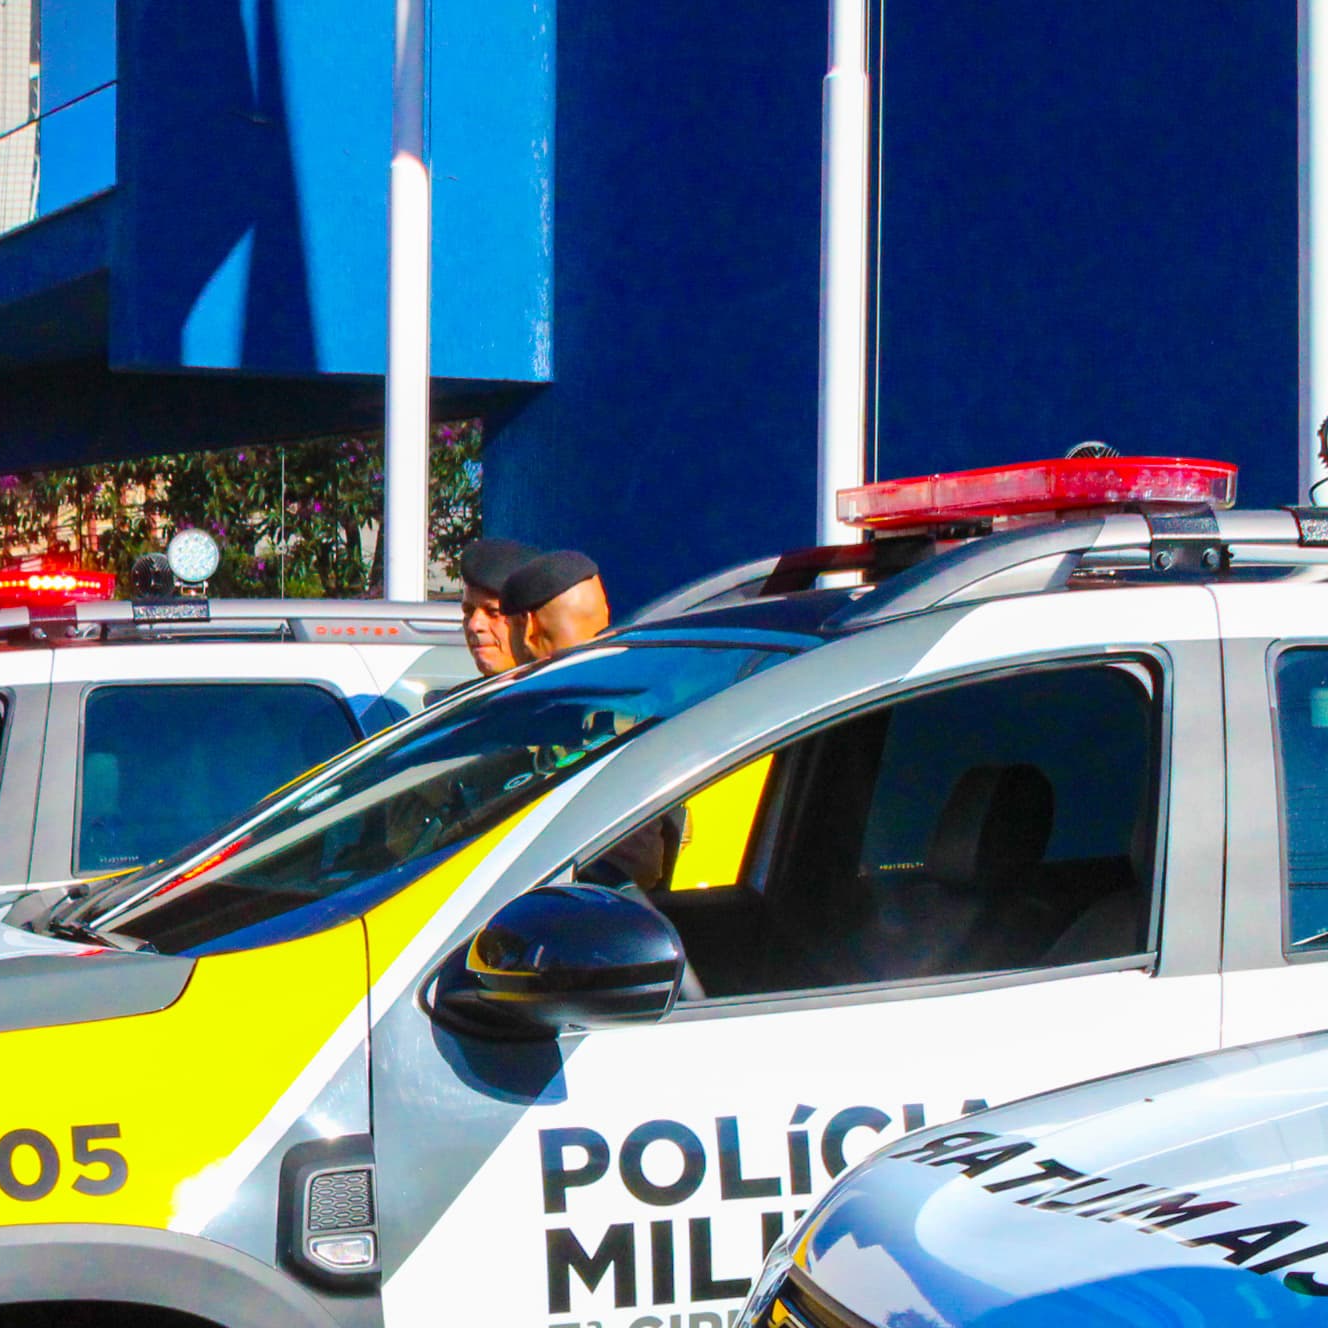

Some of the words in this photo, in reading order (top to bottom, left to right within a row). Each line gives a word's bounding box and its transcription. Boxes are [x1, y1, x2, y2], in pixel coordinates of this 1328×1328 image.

[315, 625, 400, 637] DUSTER
[538, 1099, 989, 1214] POLÍC
[545, 1209, 808, 1314] MIL
